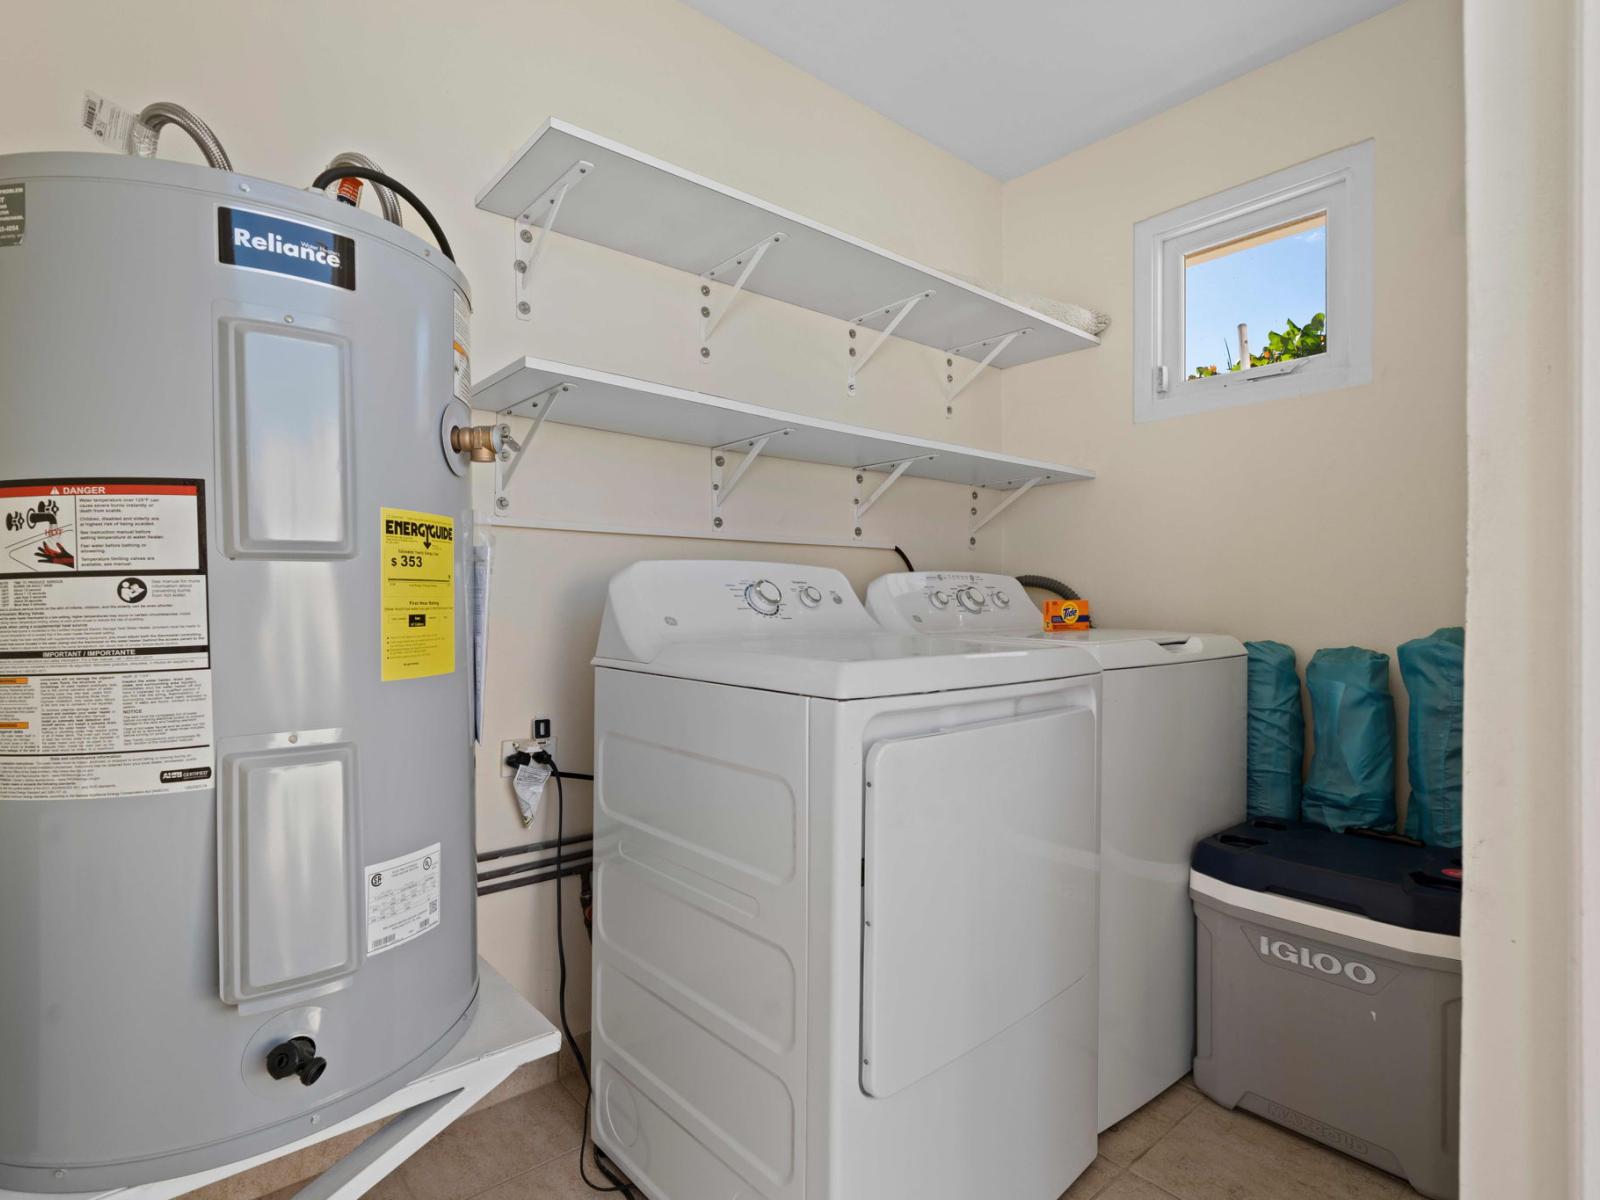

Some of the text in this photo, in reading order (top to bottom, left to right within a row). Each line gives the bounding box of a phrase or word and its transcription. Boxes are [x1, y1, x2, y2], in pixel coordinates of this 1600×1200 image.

[234, 227, 341, 268] Reliance
[63, 486, 106, 495] DANGER
[385, 519, 453, 549] ENERGYGUIDE
[391, 555, 423, 568] $ 353
[1063, 607, 1078, 619] Tide
[43, 650, 81, 658] IMPORTANT
[87, 649, 136, 657] IMPORTANTE
[1260, 936, 1376, 985] IGLOO
